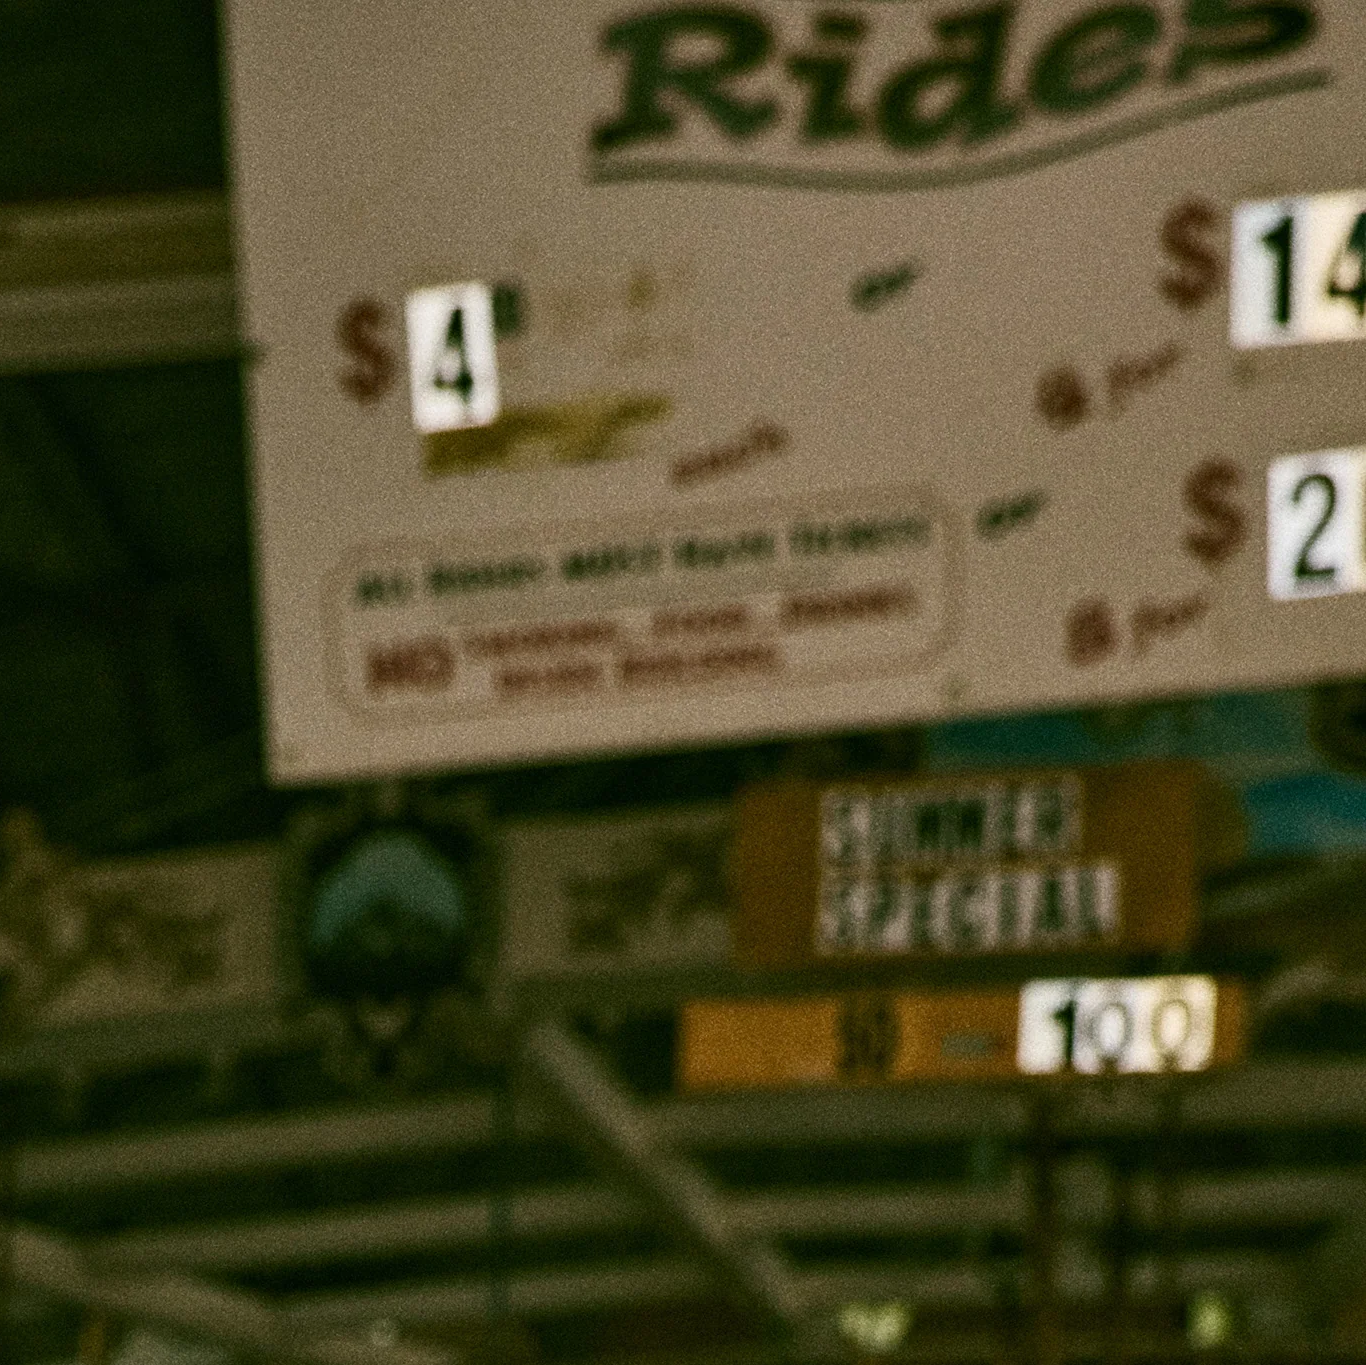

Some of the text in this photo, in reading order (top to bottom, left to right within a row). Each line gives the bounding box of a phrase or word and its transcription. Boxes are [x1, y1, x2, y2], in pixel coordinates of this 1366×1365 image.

[588, 0, 1321, 153] Rides
[1183, 455, 1366, 577] $2
[824, 866, 1112, 956] SPECIAL
